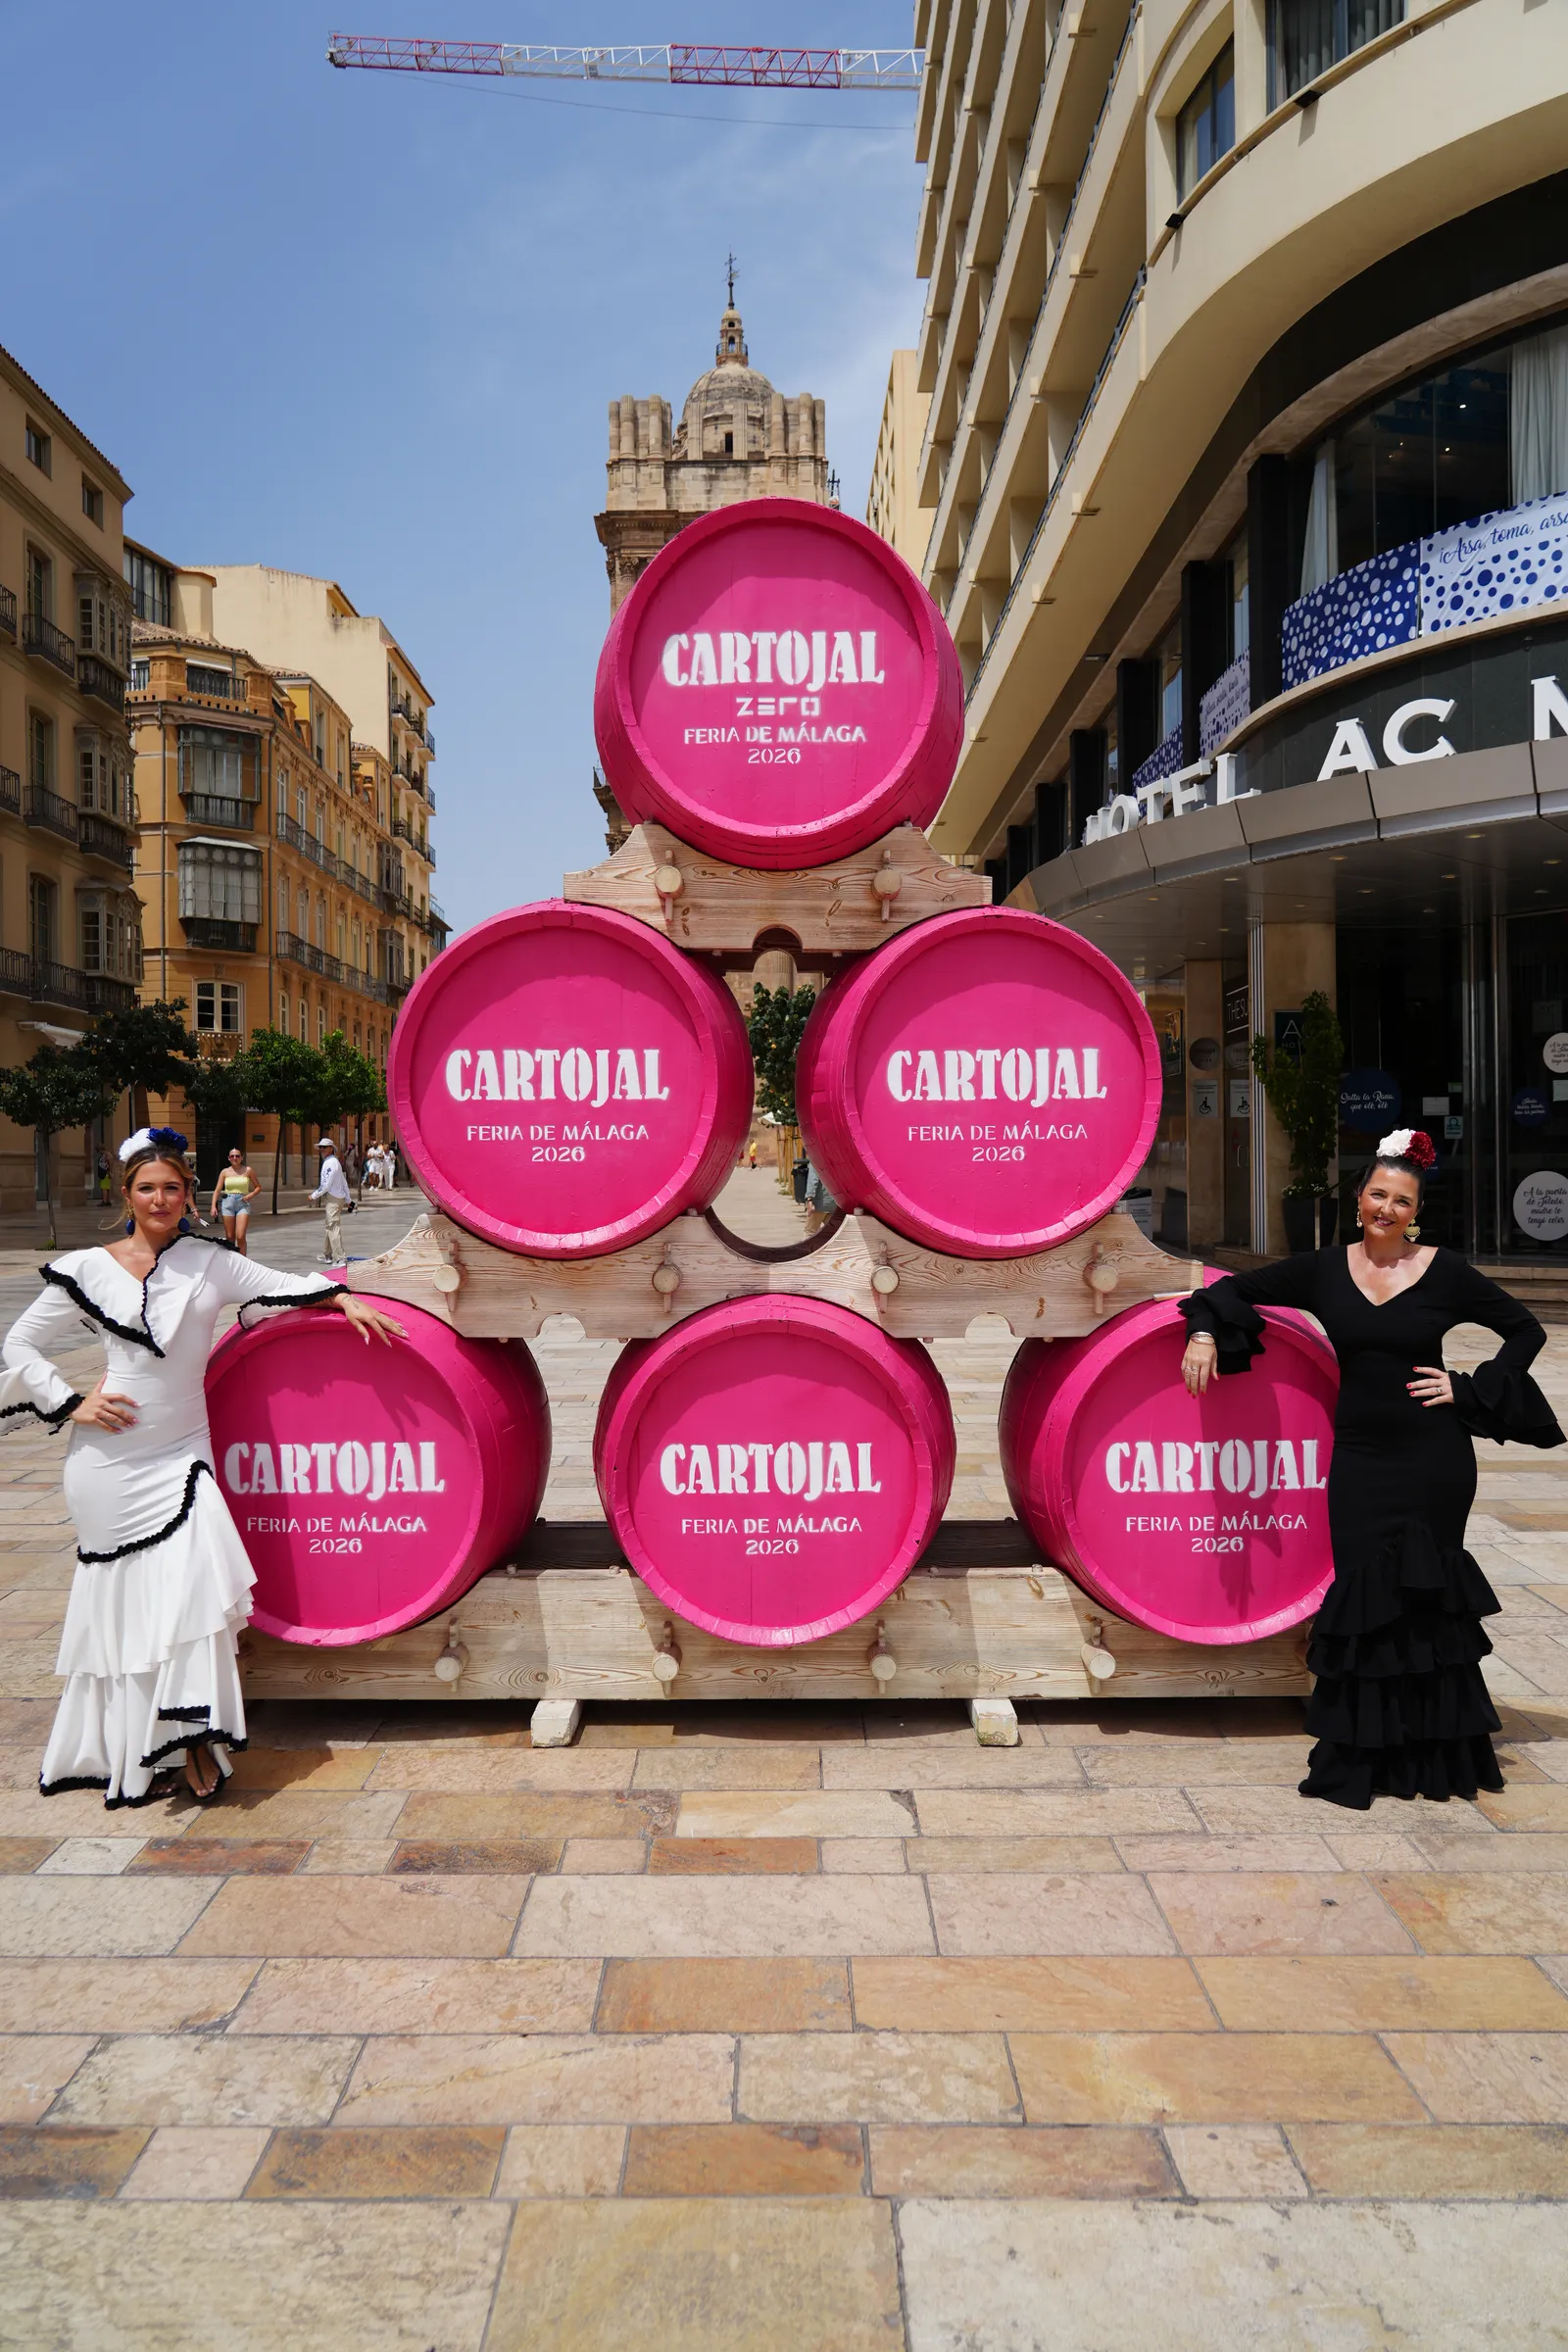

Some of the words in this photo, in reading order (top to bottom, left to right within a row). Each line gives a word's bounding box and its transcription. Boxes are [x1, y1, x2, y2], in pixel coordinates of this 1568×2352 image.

[1491, 523, 1534, 545] toma,
[662, 630, 886, 692] CARTOJAL
[684, 726, 739, 744] FERIA
[746, 726, 772, 743] DE
[778, 721, 867, 744] MÁLAGA
[748, 748, 801, 764] 2026
[1082, 753, 1262, 844] HOTEL
[1316, 697, 1458, 783] AC
[445, 1047, 669, 1107] CARTOJAL
[887, 1048, 1107, 1107] CARTOJAL
[1340, 1092, 1361, 1104] Salta
[1349, 1102, 1361, 1113] que
[466, 1125, 523, 1141] FERIA
[530, 1125, 556, 1141] DE
[563, 1120, 650, 1141] MÁLAGA
[907, 1125, 964, 1141] FERIA
[970, 1125, 996, 1141] DE
[1003, 1120, 1088, 1140] MÁLAGA
[532, 1146, 585, 1162] 2026
[972, 1146, 1025, 1161] 2026
[1523, 1187, 1535, 1199] A
[1545, 1188, 1567, 1197] puerta
[1527, 1216, 1545, 1228] tengo
[224, 1441, 445, 1500] CARTOJAL
[660, 1442, 881, 1501] CARTOJAL
[1105, 1439, 1326, 1498] CARTOJAL
[247, 1517, 301, 1532] FERIA
[307, 1517, 333, 1533] DE
[339, 1512, 427, 1532] MÁLAGA
[681, 1519, 737, 1534] FERIA
[744, 1518, 769, 1534] DE
[776, 1514, 862, 1533] MÁLAGA
[1126, 1516, 1182, 1532] FERIA
[1189, 1516, 1214, 1531] DE
[1221, 1510, 1307, 1530] MÁLAGA
[309, 1538, 363, 1553] 2026
[746, 1539, 799, 1554] 2026
[1191, 1537, 1244, 1552] 2026
